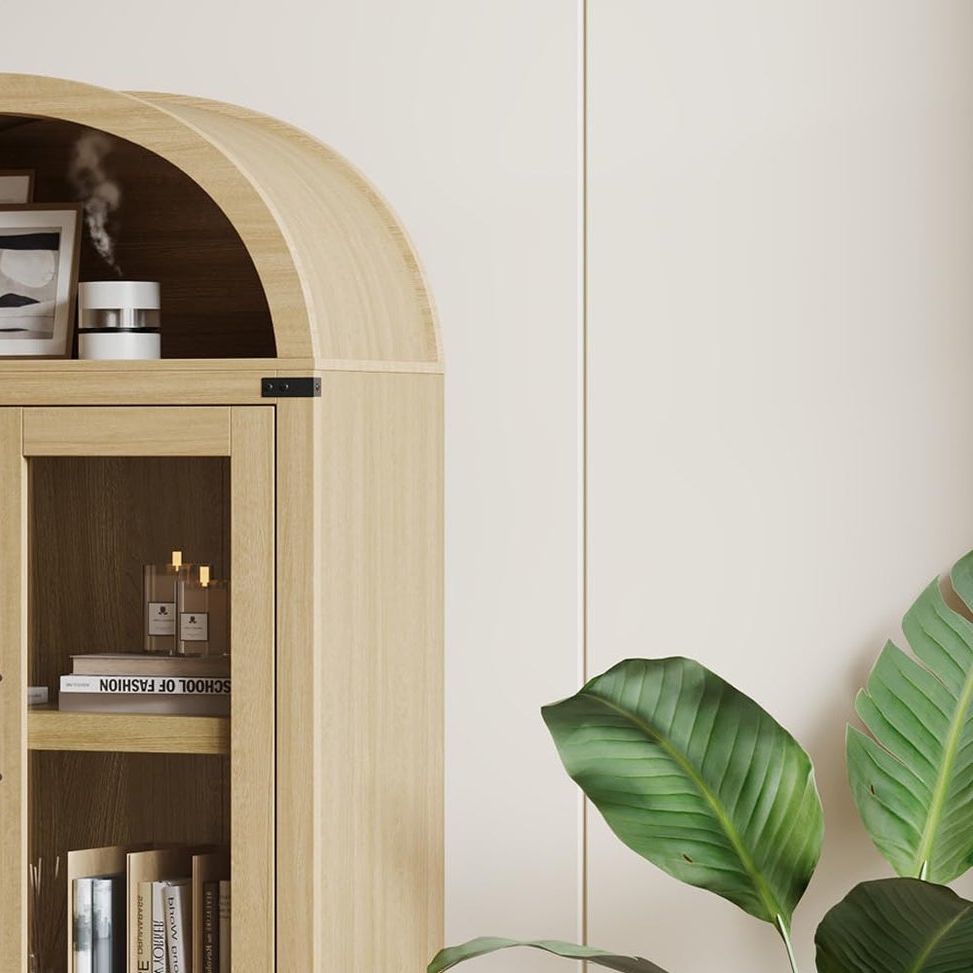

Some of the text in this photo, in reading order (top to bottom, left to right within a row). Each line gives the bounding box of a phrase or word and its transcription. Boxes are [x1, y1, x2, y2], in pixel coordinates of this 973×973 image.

[99, 678, 155, 692] FASHION
[158, 679, 175, 693] OF
[179, 679, 231, 694] SCHOOL
